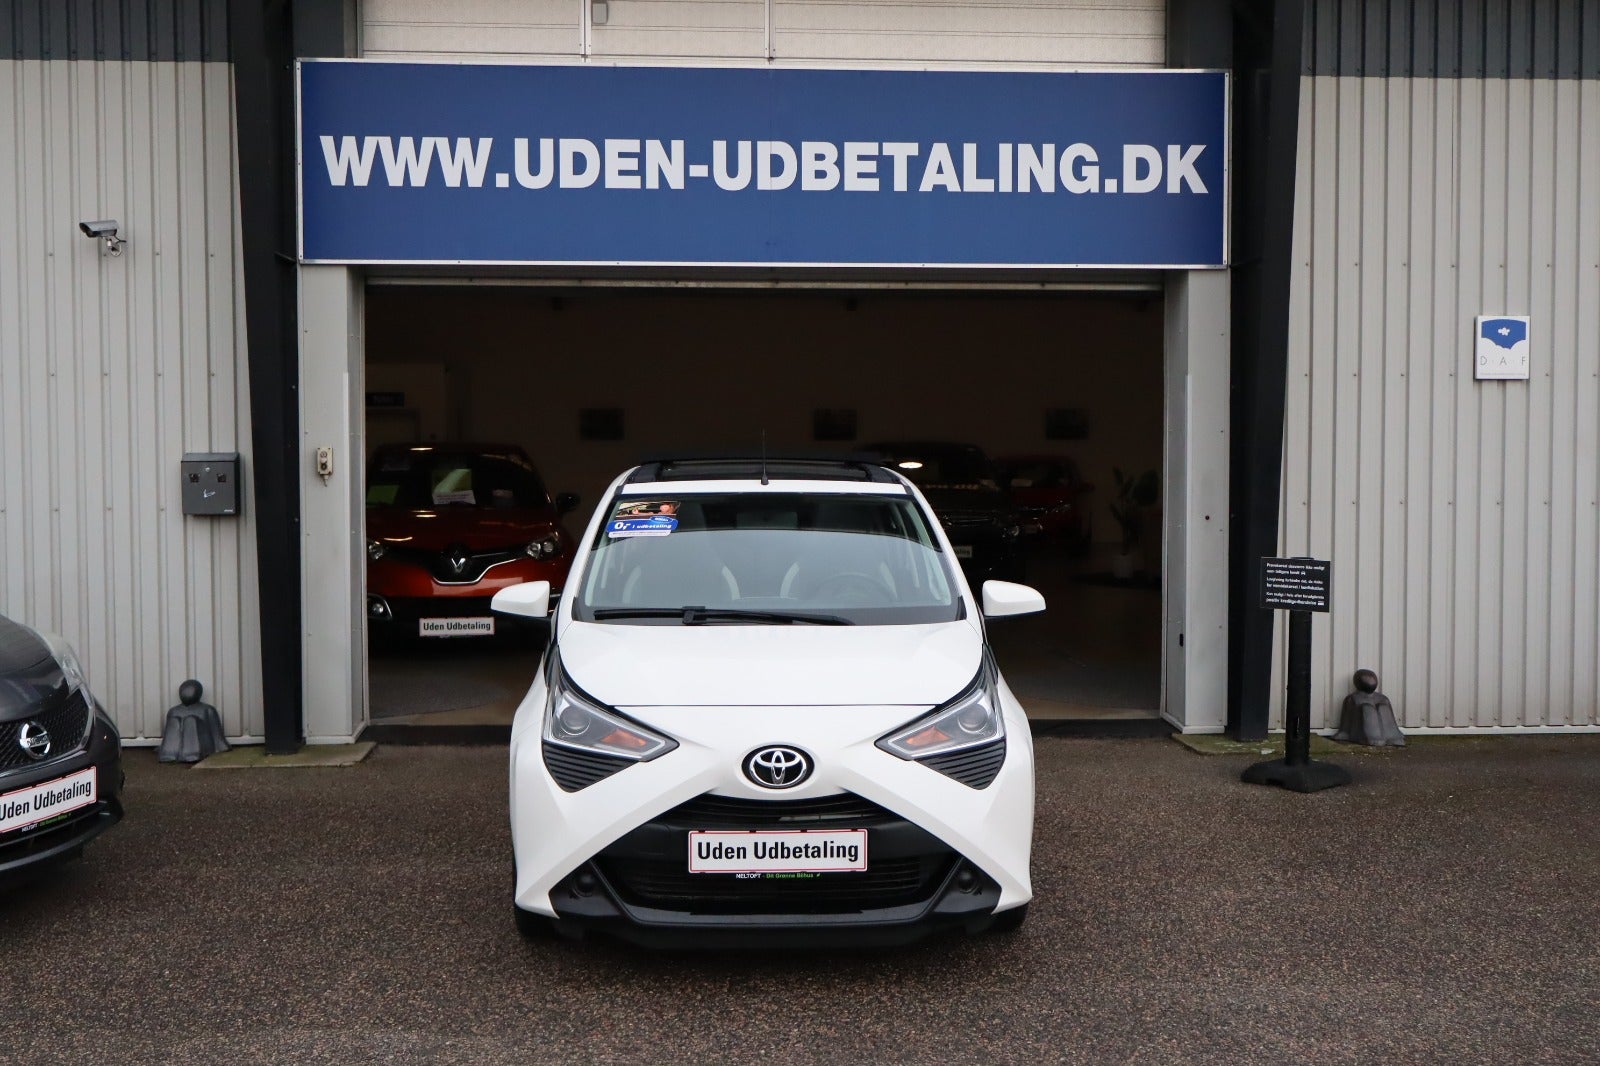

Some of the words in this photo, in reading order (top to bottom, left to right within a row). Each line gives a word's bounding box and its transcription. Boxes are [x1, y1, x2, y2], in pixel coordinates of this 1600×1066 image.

[319, 135, 1209, 195] WWW.UDEN-UDBETALING.DK
[423, 622, 444, 631] Uden
[446, 621, 491, 631] Udbetaling
[34, 781, 92, 810] Udbetaling
[697, 841, 747, 860] Uden
[754, 840, 858, 862] Udbetaling
